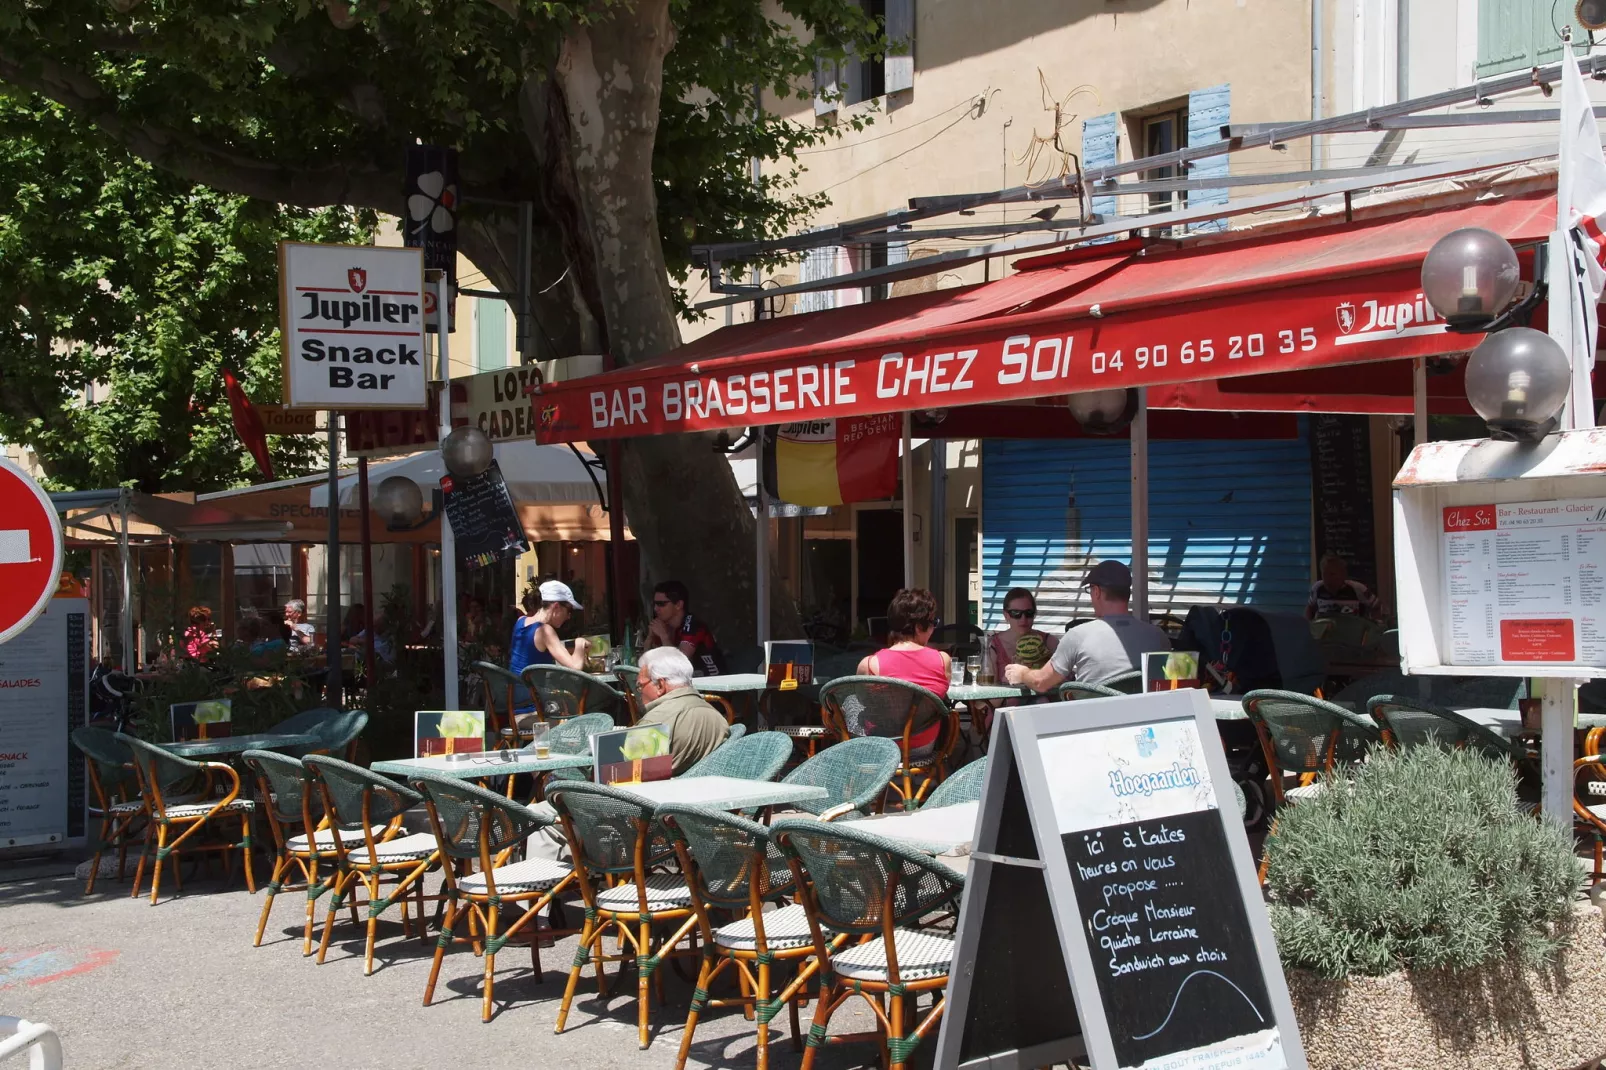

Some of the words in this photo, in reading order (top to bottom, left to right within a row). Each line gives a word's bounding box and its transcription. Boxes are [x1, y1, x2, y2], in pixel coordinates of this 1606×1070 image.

[300, 293, 419, 329] Jupiler
[301, 339, 420, 366] Snack
[590, 386, 648, 428] BAR
[663, 360, 857, 421] BRASSERIE
[876, 349, 978, 399] CHEZ
[997, 334, 1074, 385] SOI
[1091, 352, 1124, 374] 04
[1135, 345, 1167, 369] 90
[1180, 339, 1215, 364] 65
[1228, 333, 1264, 359] 20
[1278, 327, 1318, 353] 35
[1359, 293, 1446, 334] Jupil
[329, 366, 396, 390] Bar
[493, 367, 544, 403] LOTO
[264, 410, 314, 425] Tabac
[478, 406, 536, 439] CADEA
[851, 414, 895, 432] BELGIAN
[843, 432, 864, 443] RED
[867, 423, 897, 435] DEVIL
[1447, 511, 1471, 528] Chez
[1474, 510, 1491, 526] Soi
[1498, 509, 1511, 517] Bar
[1518, 505, 1559, 516] Restaurant
[1565, 504, 1594, 513] Glacier
[1108, 762, 1201, 796] Hoegaarden
[1084, 831, 1104, 856] ici
[1122, 831, 1137, 848] à
[1077, 861, 1117, 881] heures
[1121, 859, 1137, 872] on
[1143, 855, 1176, 870] vous
[1102, 879, 1159, 907] propose
[1092, 909, 1139, 931] Croque
[1144, 900, 1196, 922] Monsieur
[1149, 925, 1199, 942] Lorraine
[1109, 953, 1165, 977] Sandwich
[1196, 946, 1228, 963] choix
